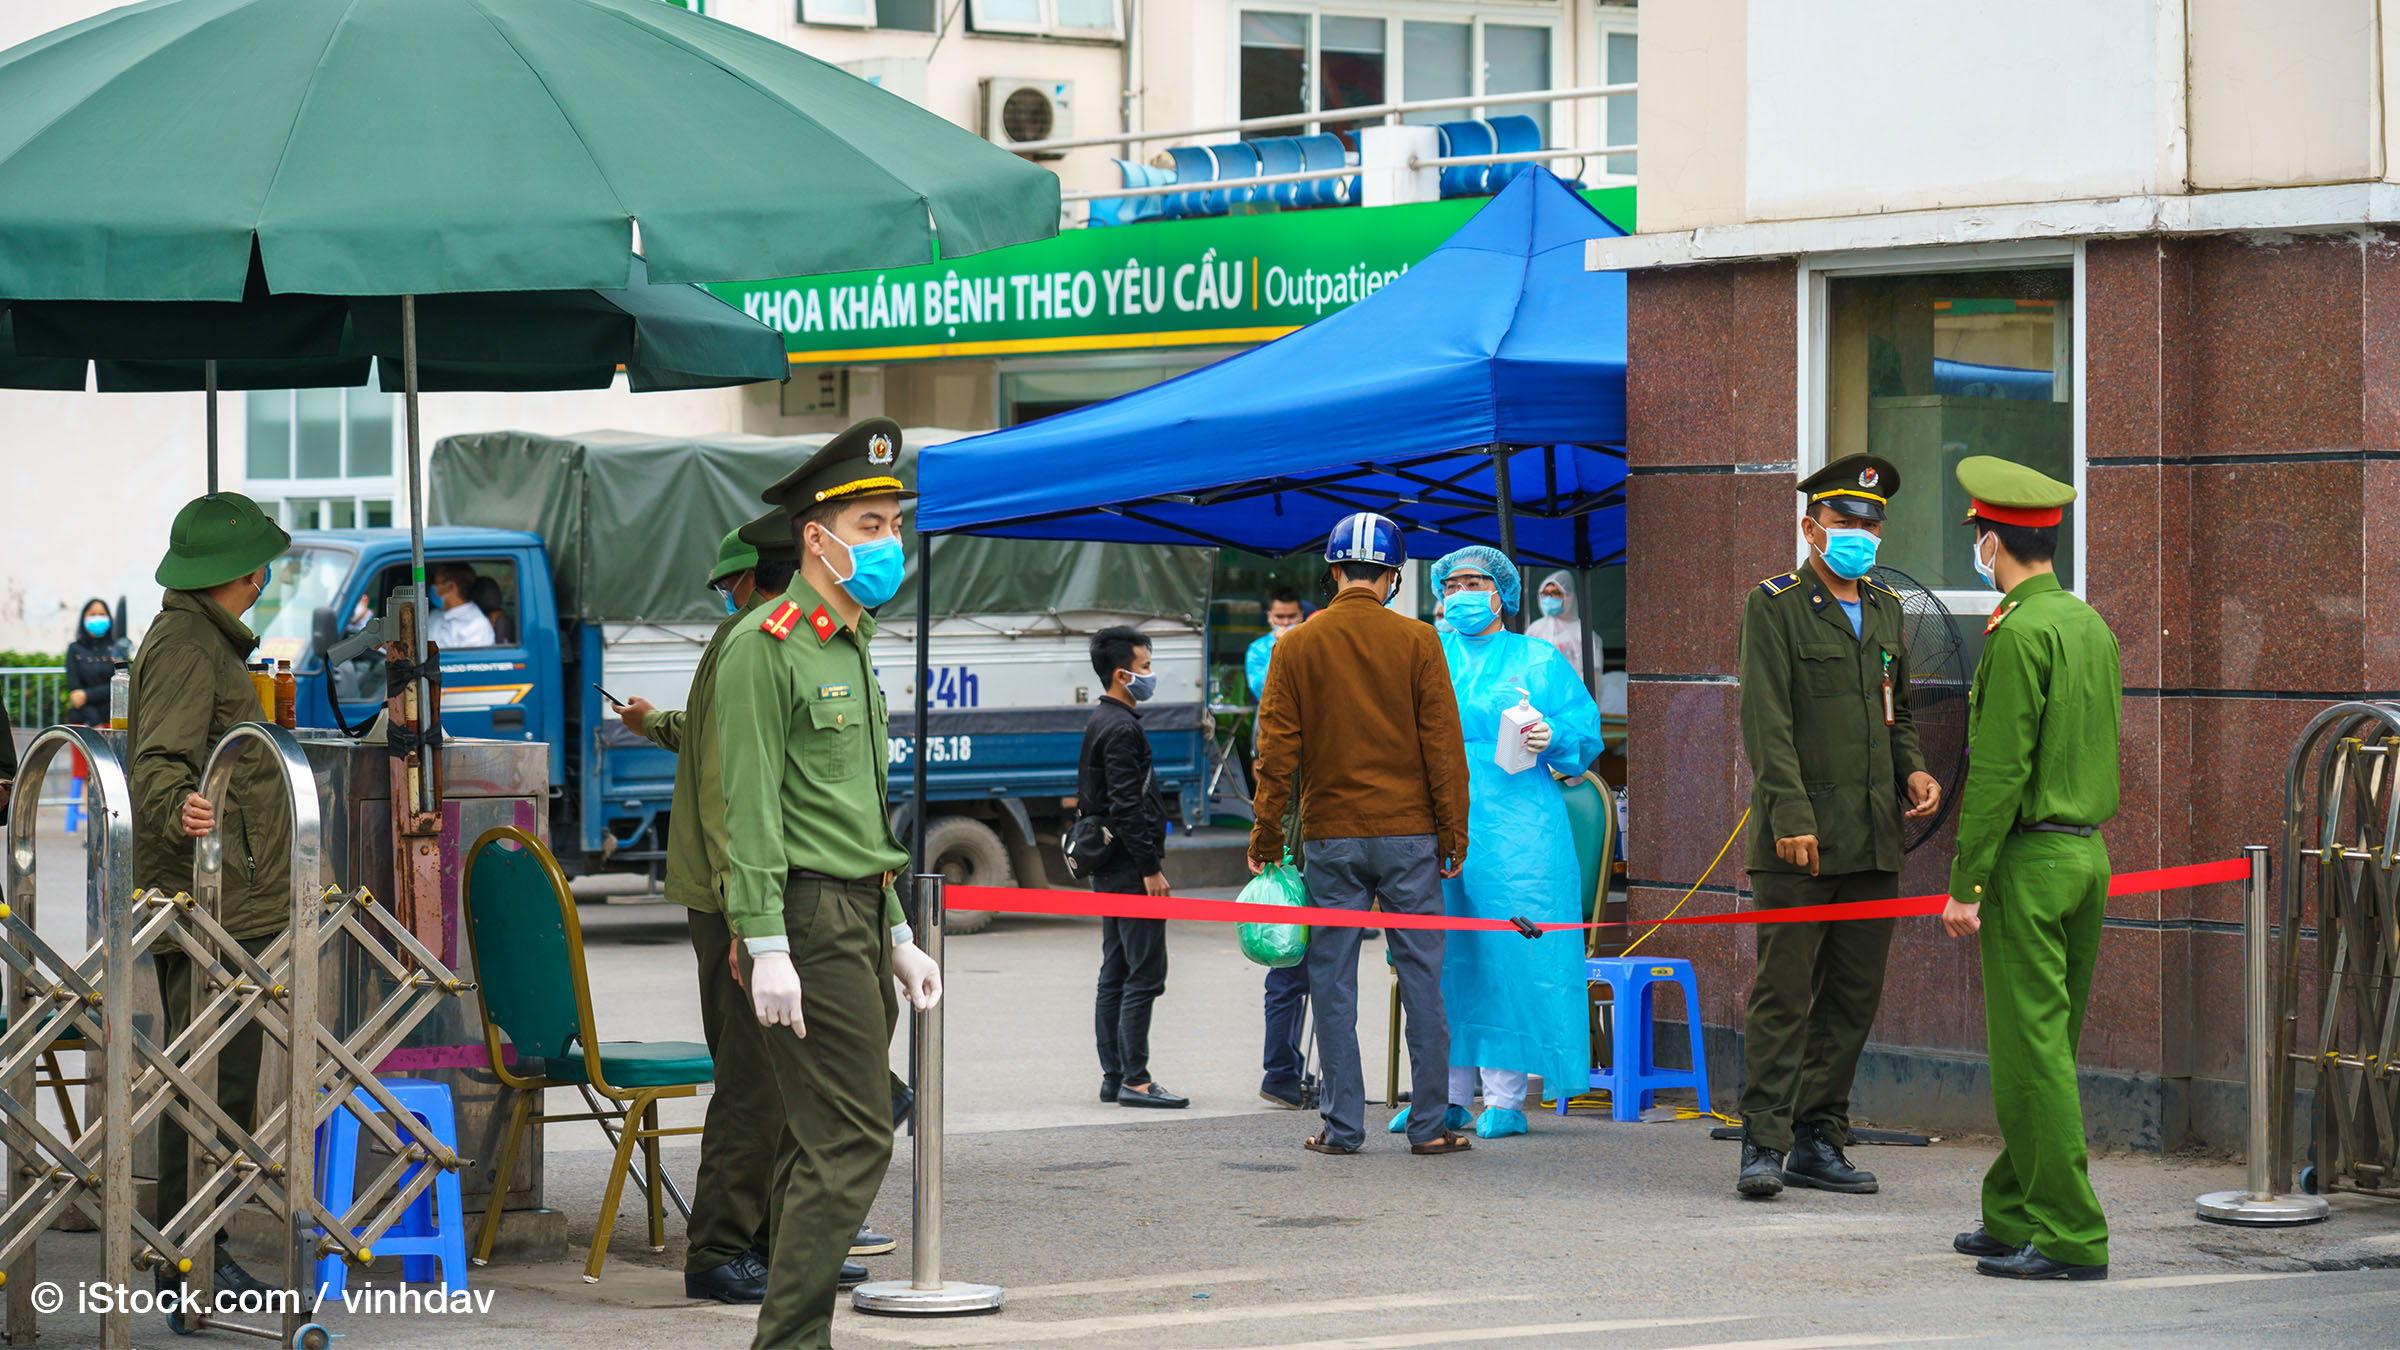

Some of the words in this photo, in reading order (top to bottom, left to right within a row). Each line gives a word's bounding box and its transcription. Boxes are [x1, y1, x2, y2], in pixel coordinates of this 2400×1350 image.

[744, 288, 824, 333] KHOA
[830, 275, 917, 331] KHÁM
[924, 270, 1004, 337] BỆNH
[1010, 270, 1096, 320] THEO
[1102, 258, 1165, 315] YÊU
[1174, 247, 1243, 311] CẦU
[1265, 262, 1408, 315] Outpatien
